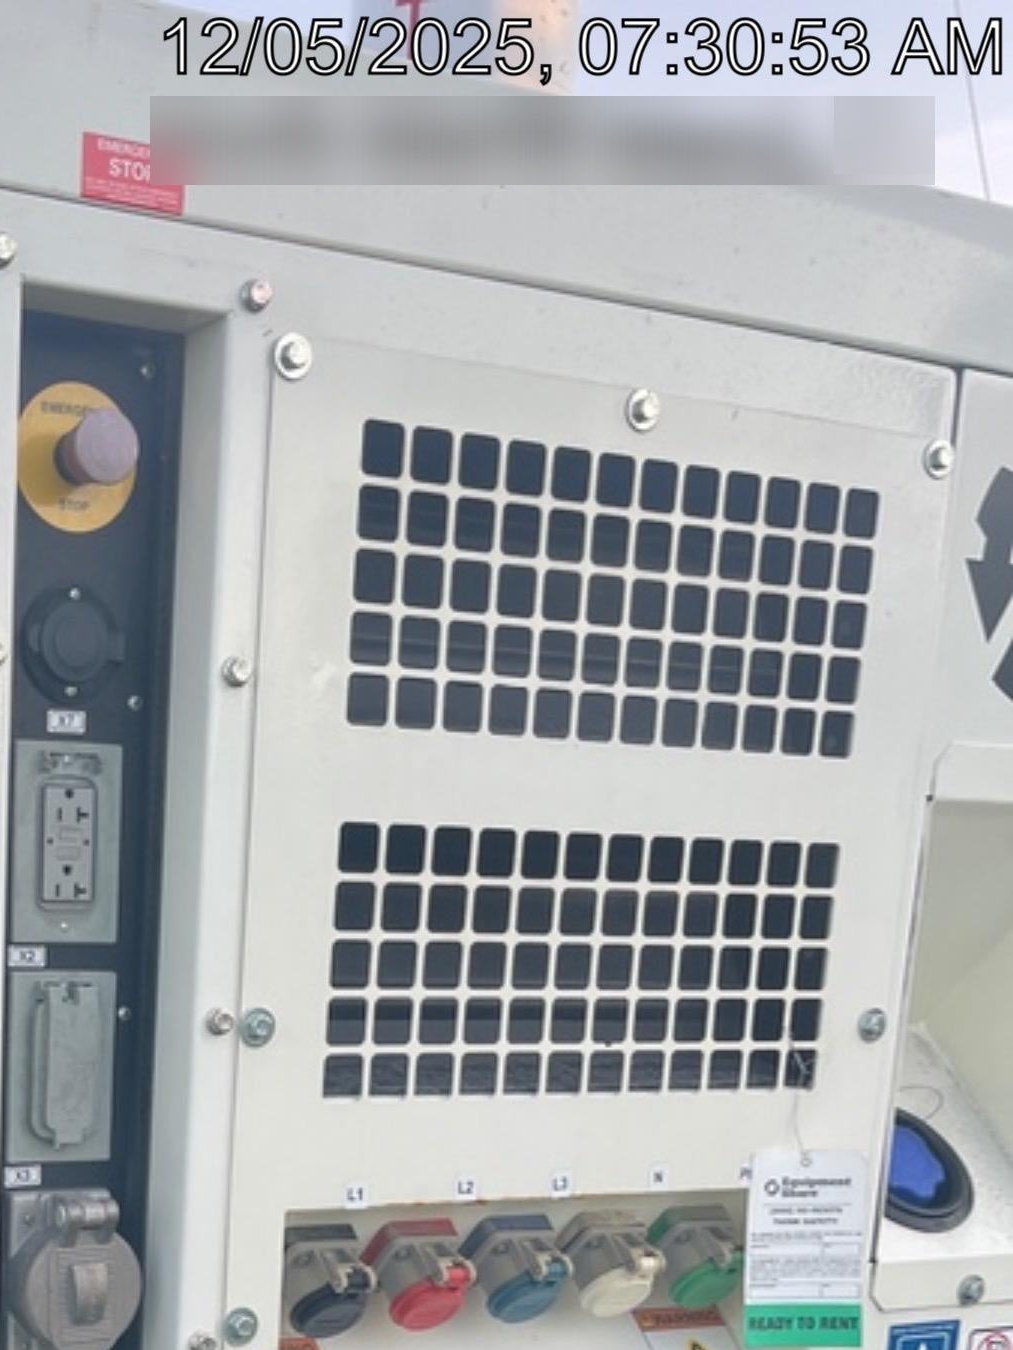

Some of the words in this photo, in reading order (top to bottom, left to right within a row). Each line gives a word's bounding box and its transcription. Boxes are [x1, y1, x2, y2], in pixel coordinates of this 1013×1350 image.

[97, 138, 150, 159] EMERGE
[41, 401, 88, 417] EMERG
[346, 1187, 365, 1202] L1
[457, 1180, 475, 1195] L2
[748, 1317, 792, 1331] READY
[797, 1316, 816, 1331] TO
[820, 1316, 860, 1330] RENT
